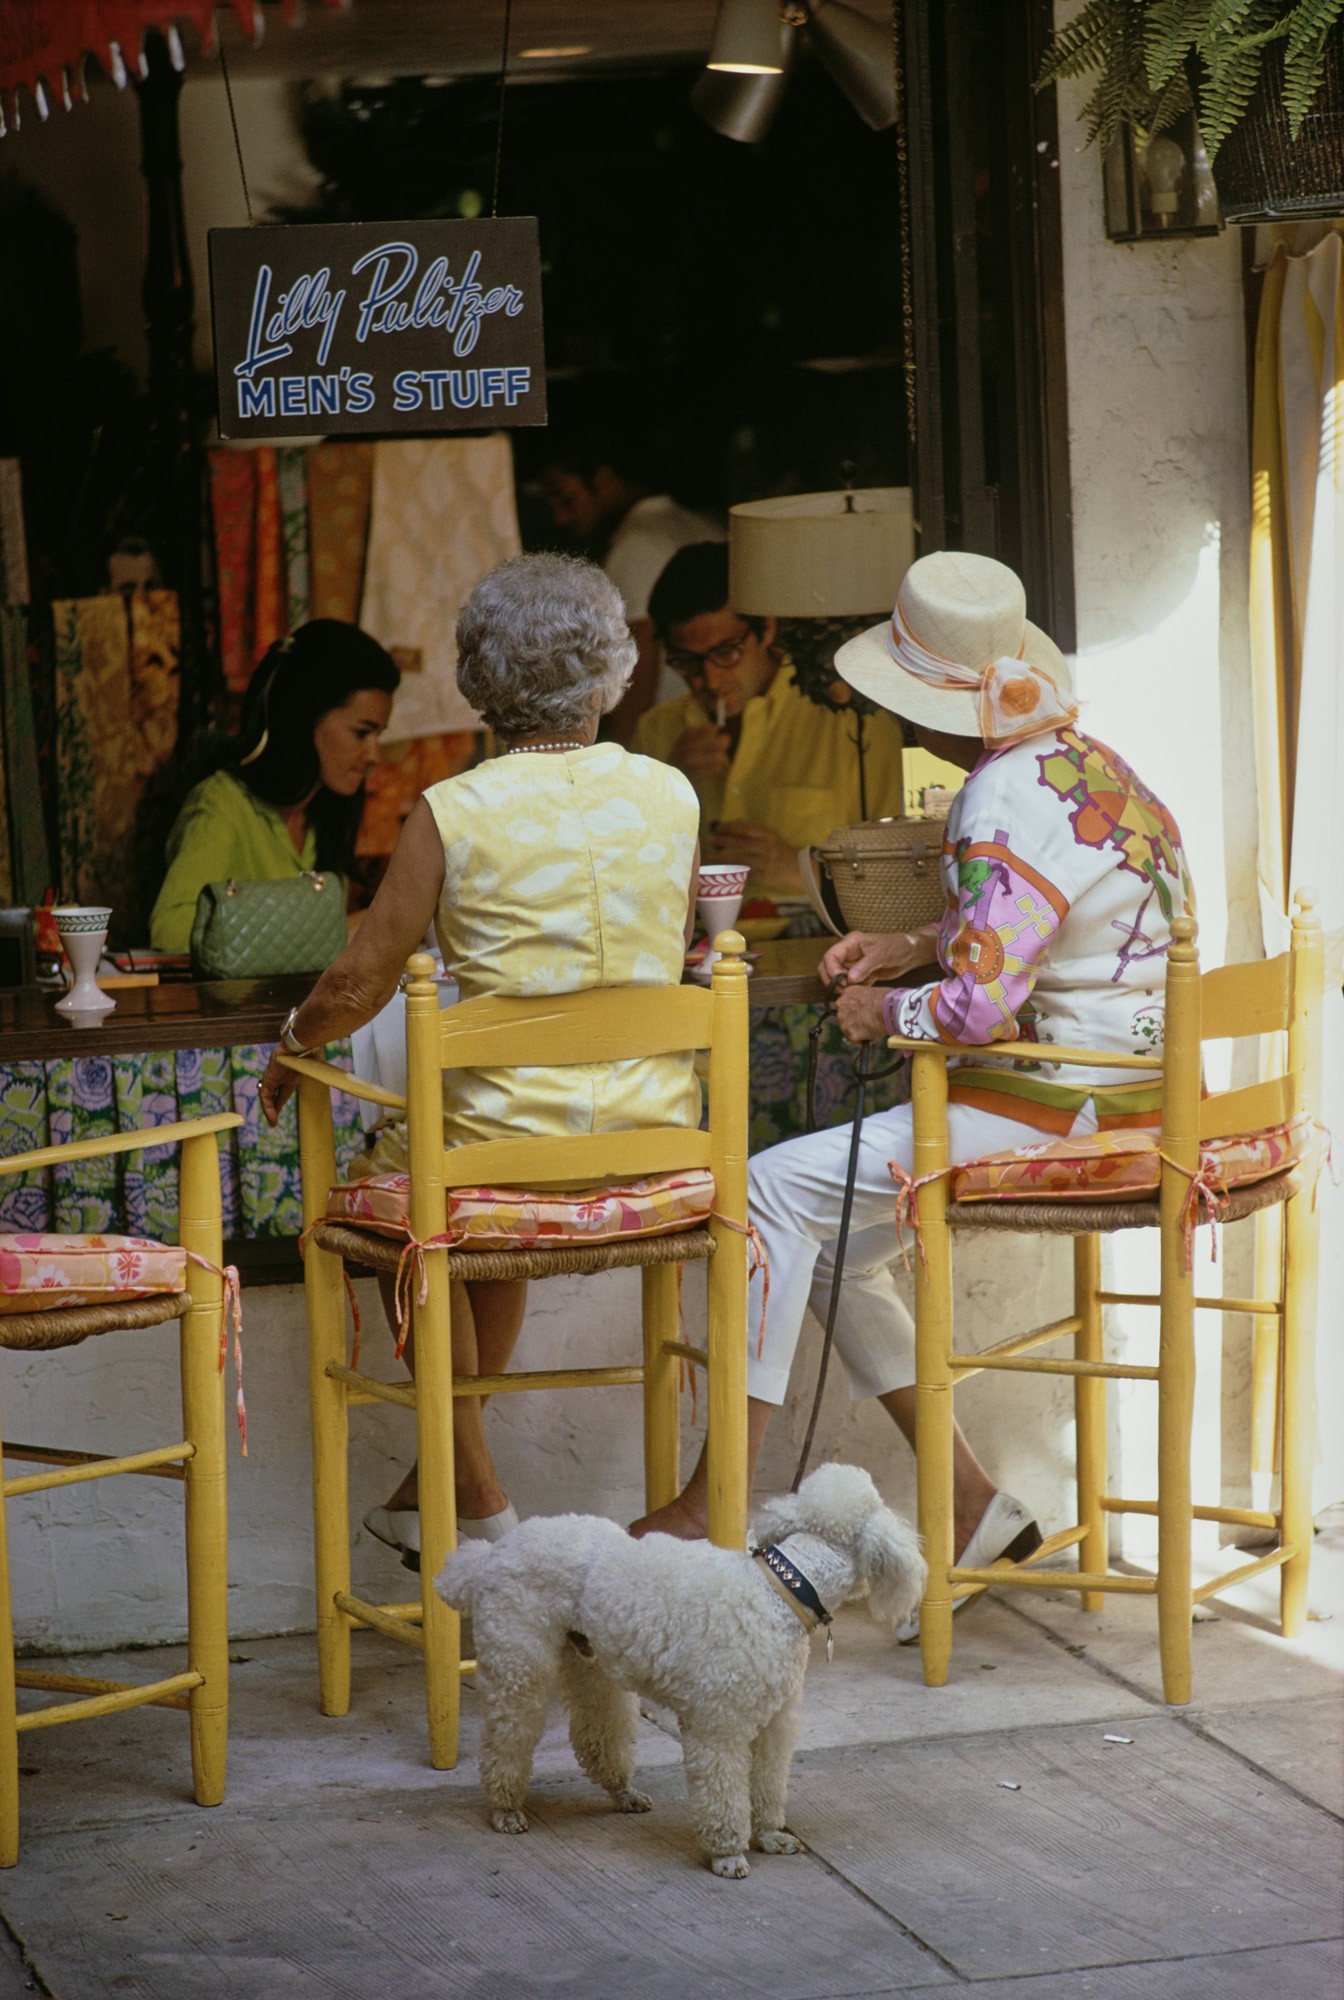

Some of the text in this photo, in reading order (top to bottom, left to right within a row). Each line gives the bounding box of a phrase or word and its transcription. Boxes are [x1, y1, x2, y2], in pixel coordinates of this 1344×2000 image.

[234, 242, 523, 377] Lilly Pulitzer
[237, 366, 531, 418] MEN'S STUFF
